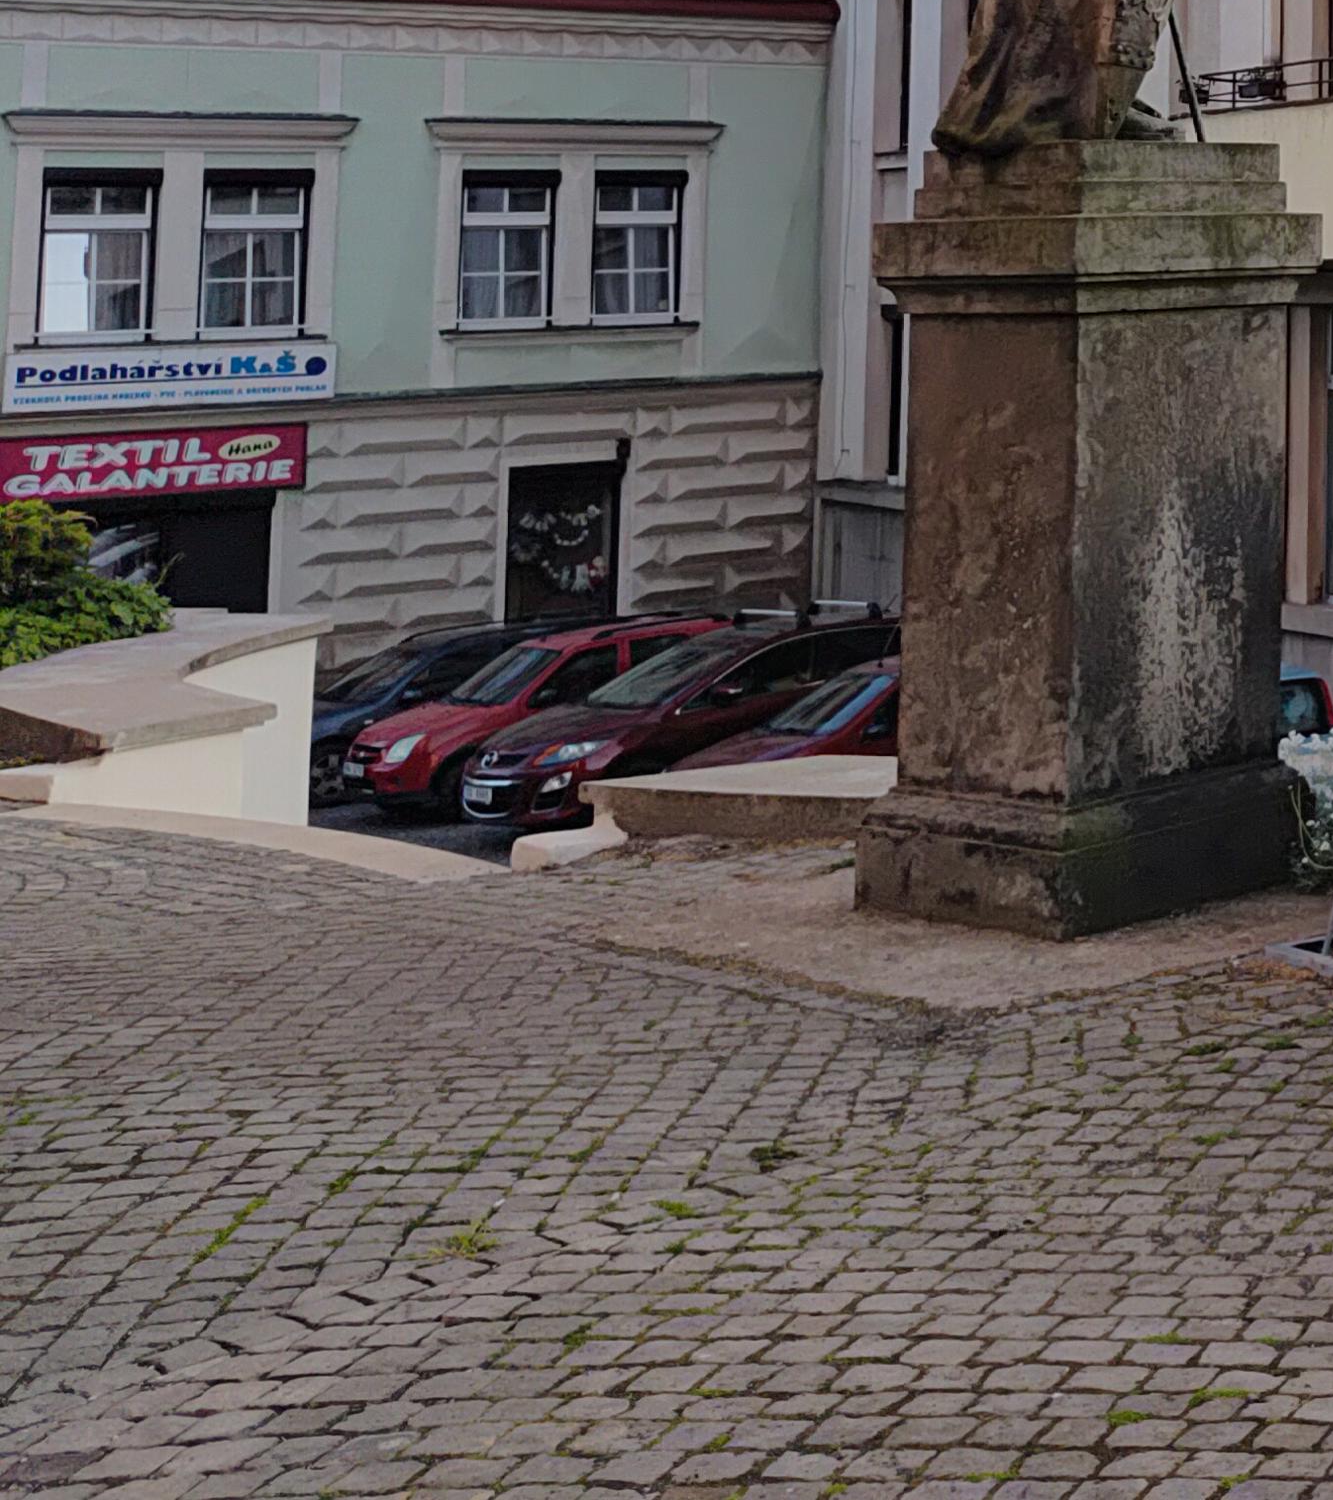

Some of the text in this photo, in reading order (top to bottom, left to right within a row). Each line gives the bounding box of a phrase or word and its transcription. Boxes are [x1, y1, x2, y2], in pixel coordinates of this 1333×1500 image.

[16, 357, 223, 384] Podlahářství
[23, 437, 212, 472] TEXTIL
[3, 459, 295, 498] GALANTERIE
